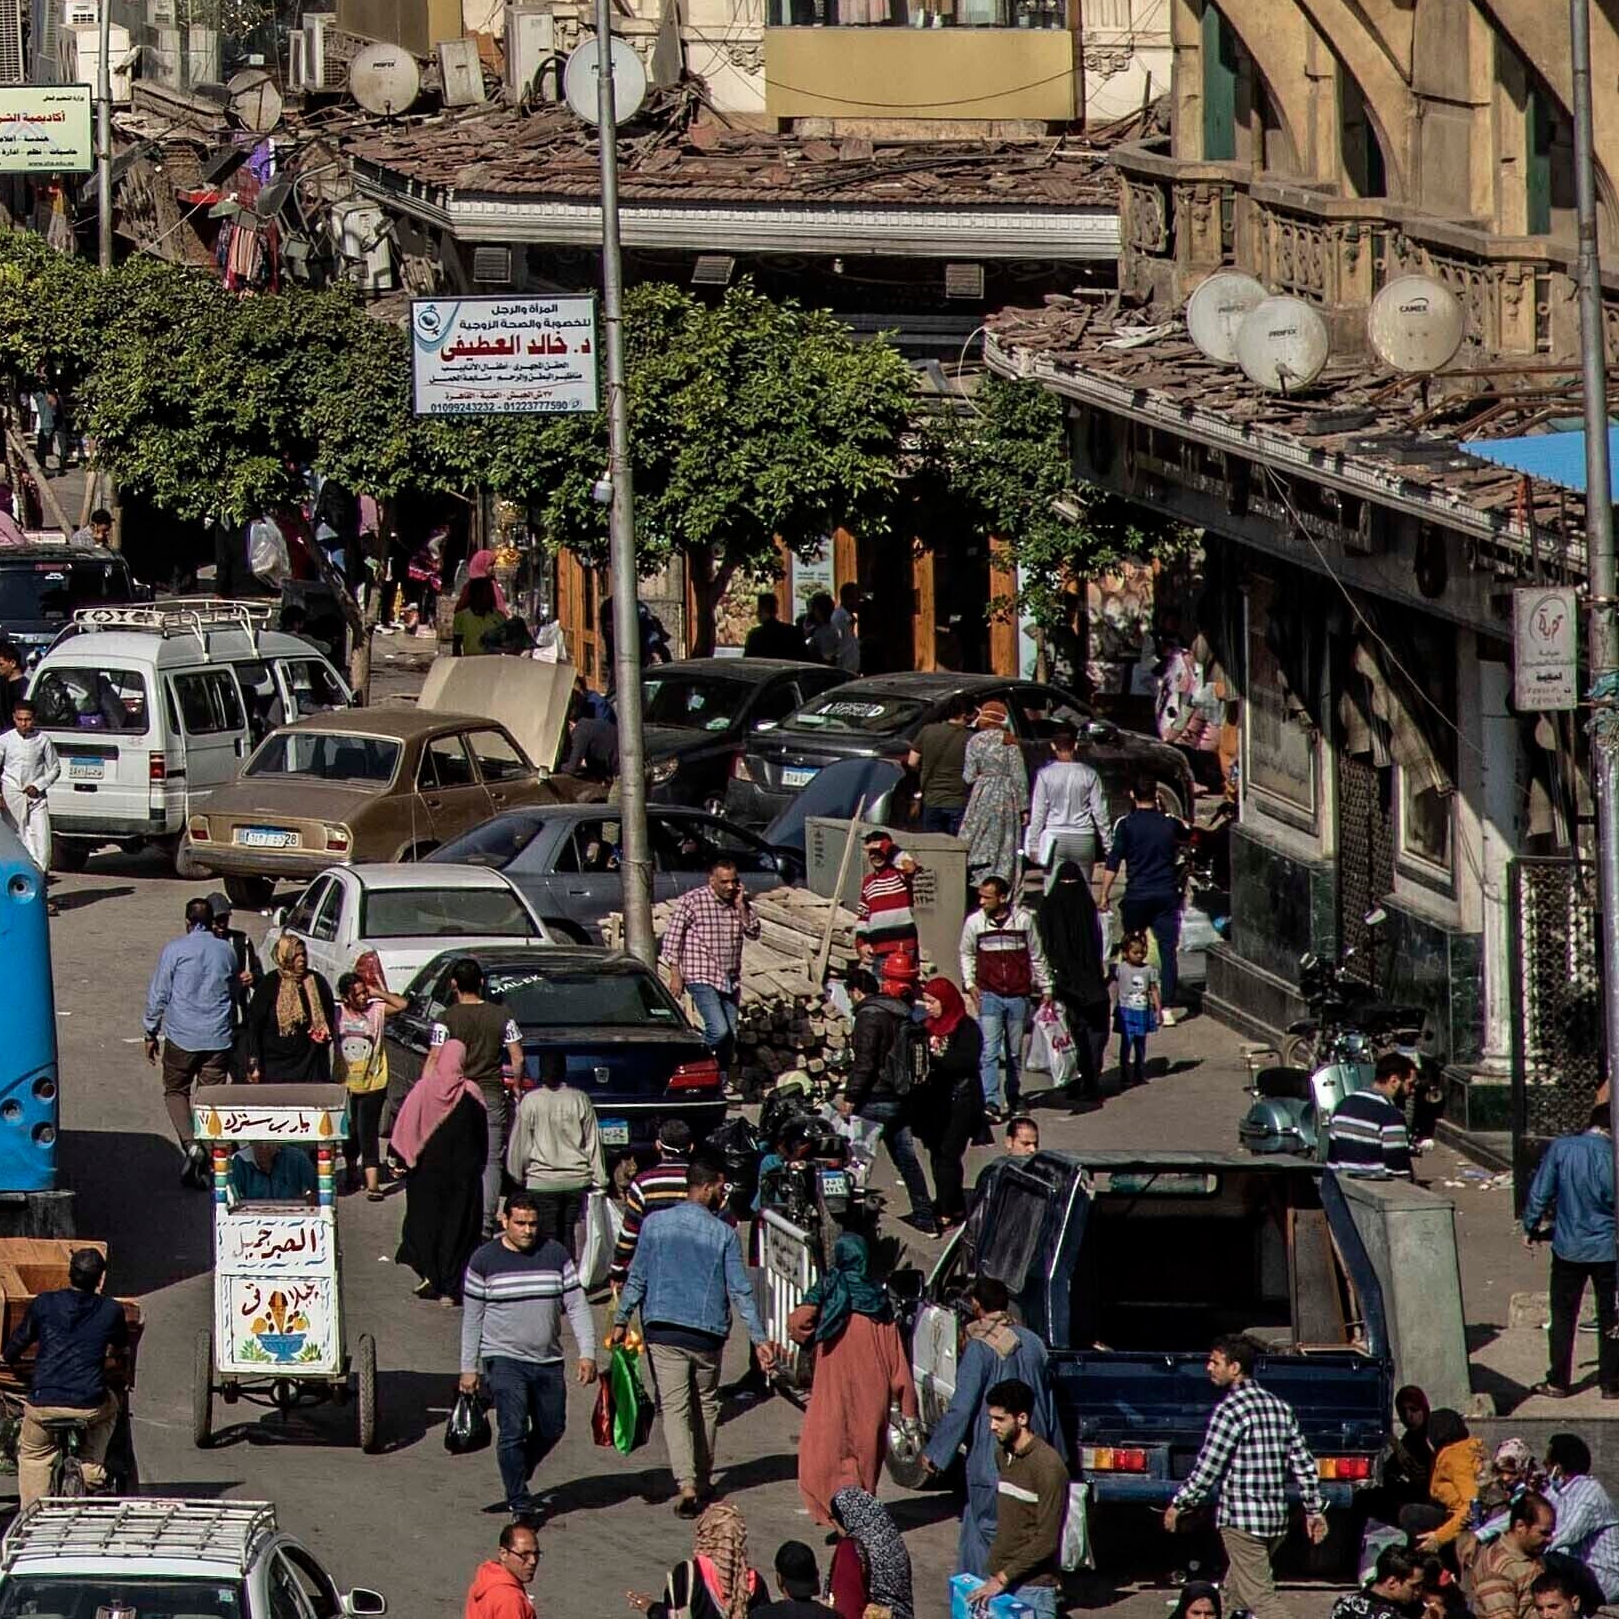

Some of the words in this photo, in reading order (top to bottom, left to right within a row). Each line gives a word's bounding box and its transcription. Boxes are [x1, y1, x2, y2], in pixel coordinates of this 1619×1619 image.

[22, 110, 65, 125] أكاديمية
[491, 305, 528, 316] والرجل
[459, 320, 499, 331] الزوجية
[500, 319, 541, 330] والصحة
[543, 319, 591, 330] للخصوبة
[441, 332, 521, 362] العطيفى
[527, 331, 568, 355] خالد
[503, 401, 568, 411] 01223777590
[261, 1227, 317, 1260] الصبر
